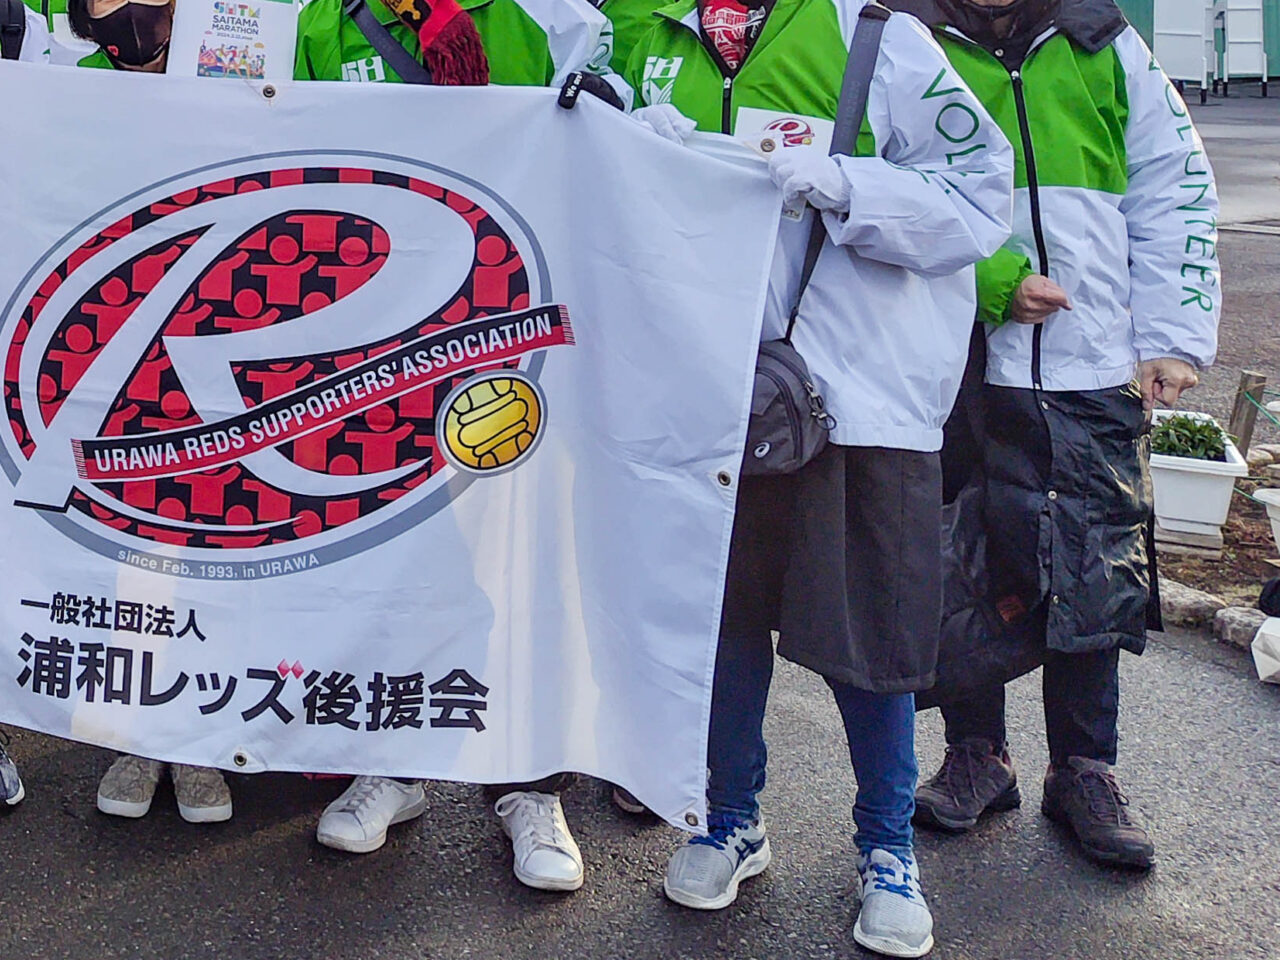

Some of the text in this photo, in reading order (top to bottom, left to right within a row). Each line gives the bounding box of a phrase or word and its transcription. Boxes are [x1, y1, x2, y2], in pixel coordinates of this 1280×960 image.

[211, 24, 259, 36] MARATHON
[213, 15, 259, 28] SAITAMA
[94, 313, 553, 474] URAWA REDS SUPPORTERS' ASSOCIATION
[117, 549, 157, 569] since
[162, 561, 194, 576] Feb.
[242, 566, 256, 578] in
[259, 553, 320, 575] URAWA
[20, 591, 207, 643] 一般社団法人
[16, 632, 490, 733] 浦和レッズ後援会
